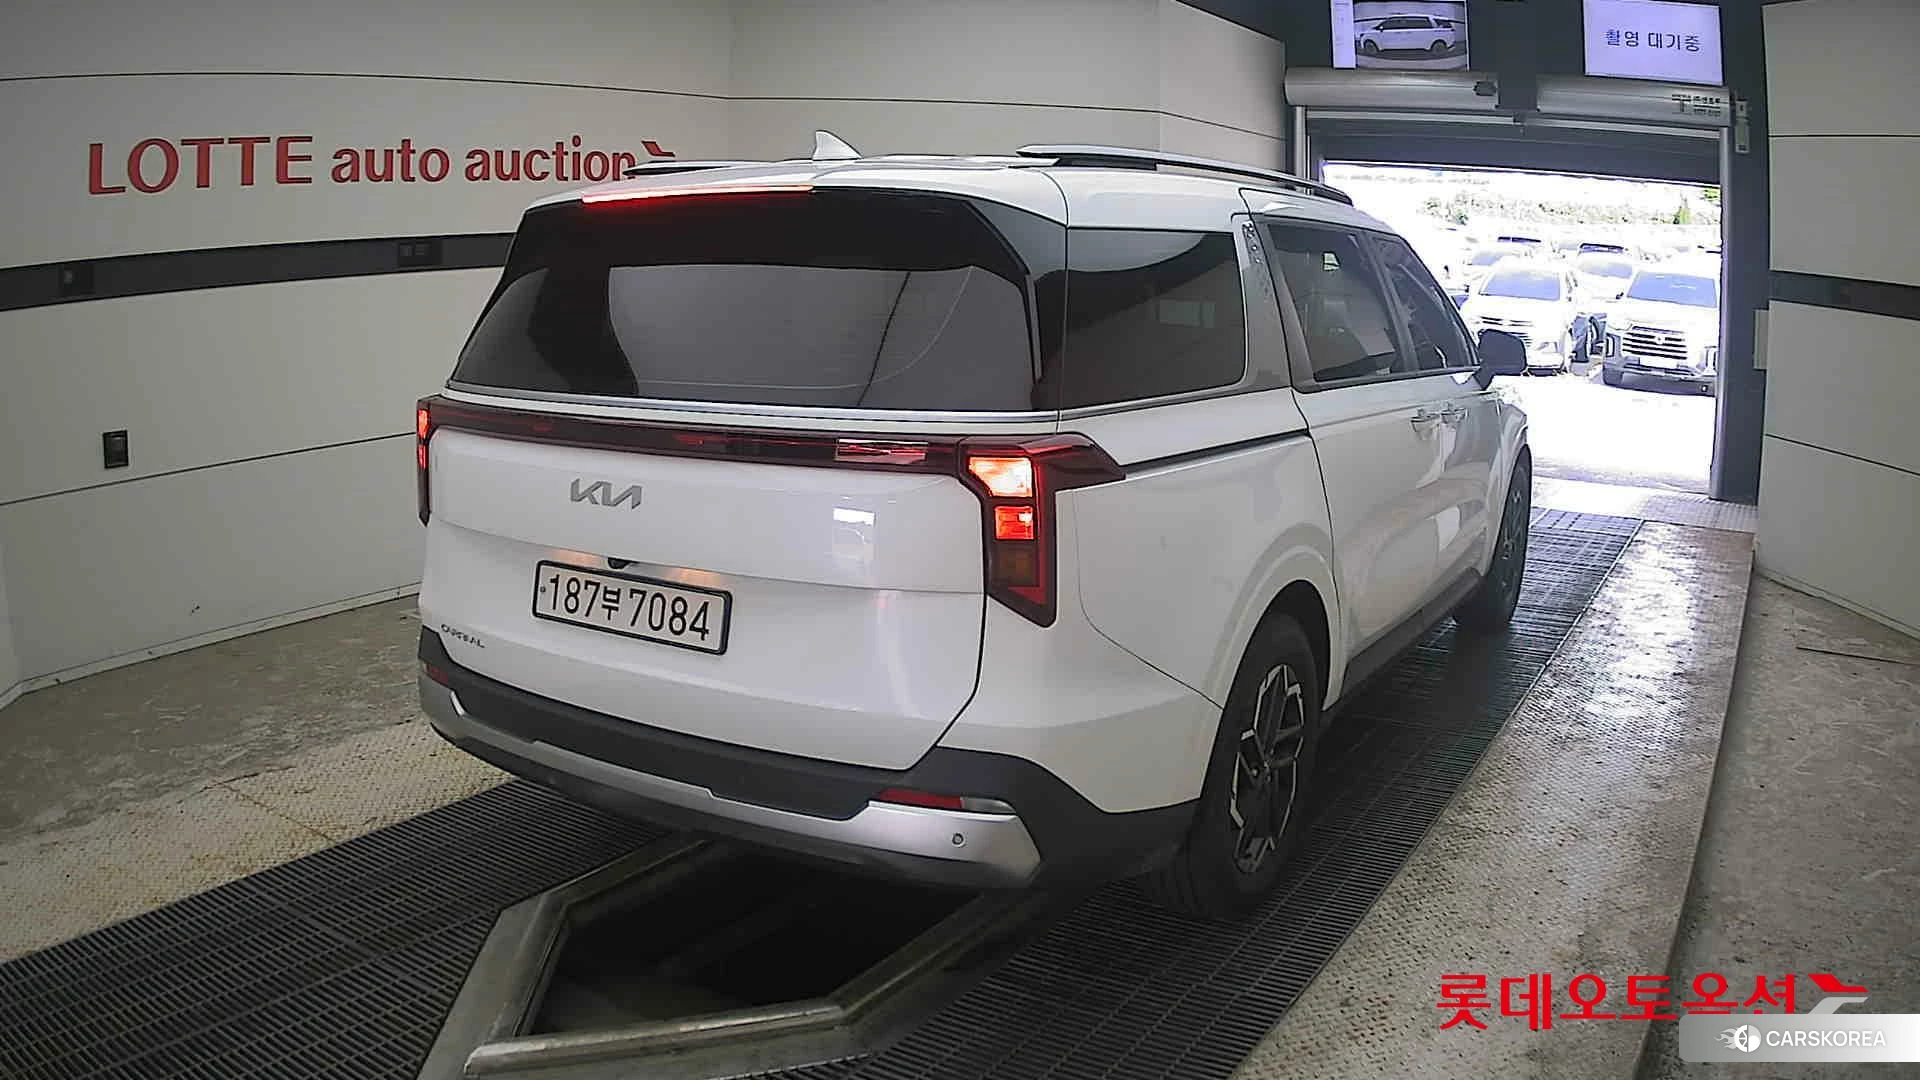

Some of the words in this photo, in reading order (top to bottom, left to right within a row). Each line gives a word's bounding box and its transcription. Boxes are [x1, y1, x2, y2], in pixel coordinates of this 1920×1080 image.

[1648, 32, 1700, 52] 대기중
[89, 136, 312, 195] LOTTE
[331, 138, 450, 183] auto
[464, 135, 636, 181] auction
[570, 478, 642, 509] KIA
[549, 573, 622, 621] 187부
[629, 588, 710, 641] 7084
